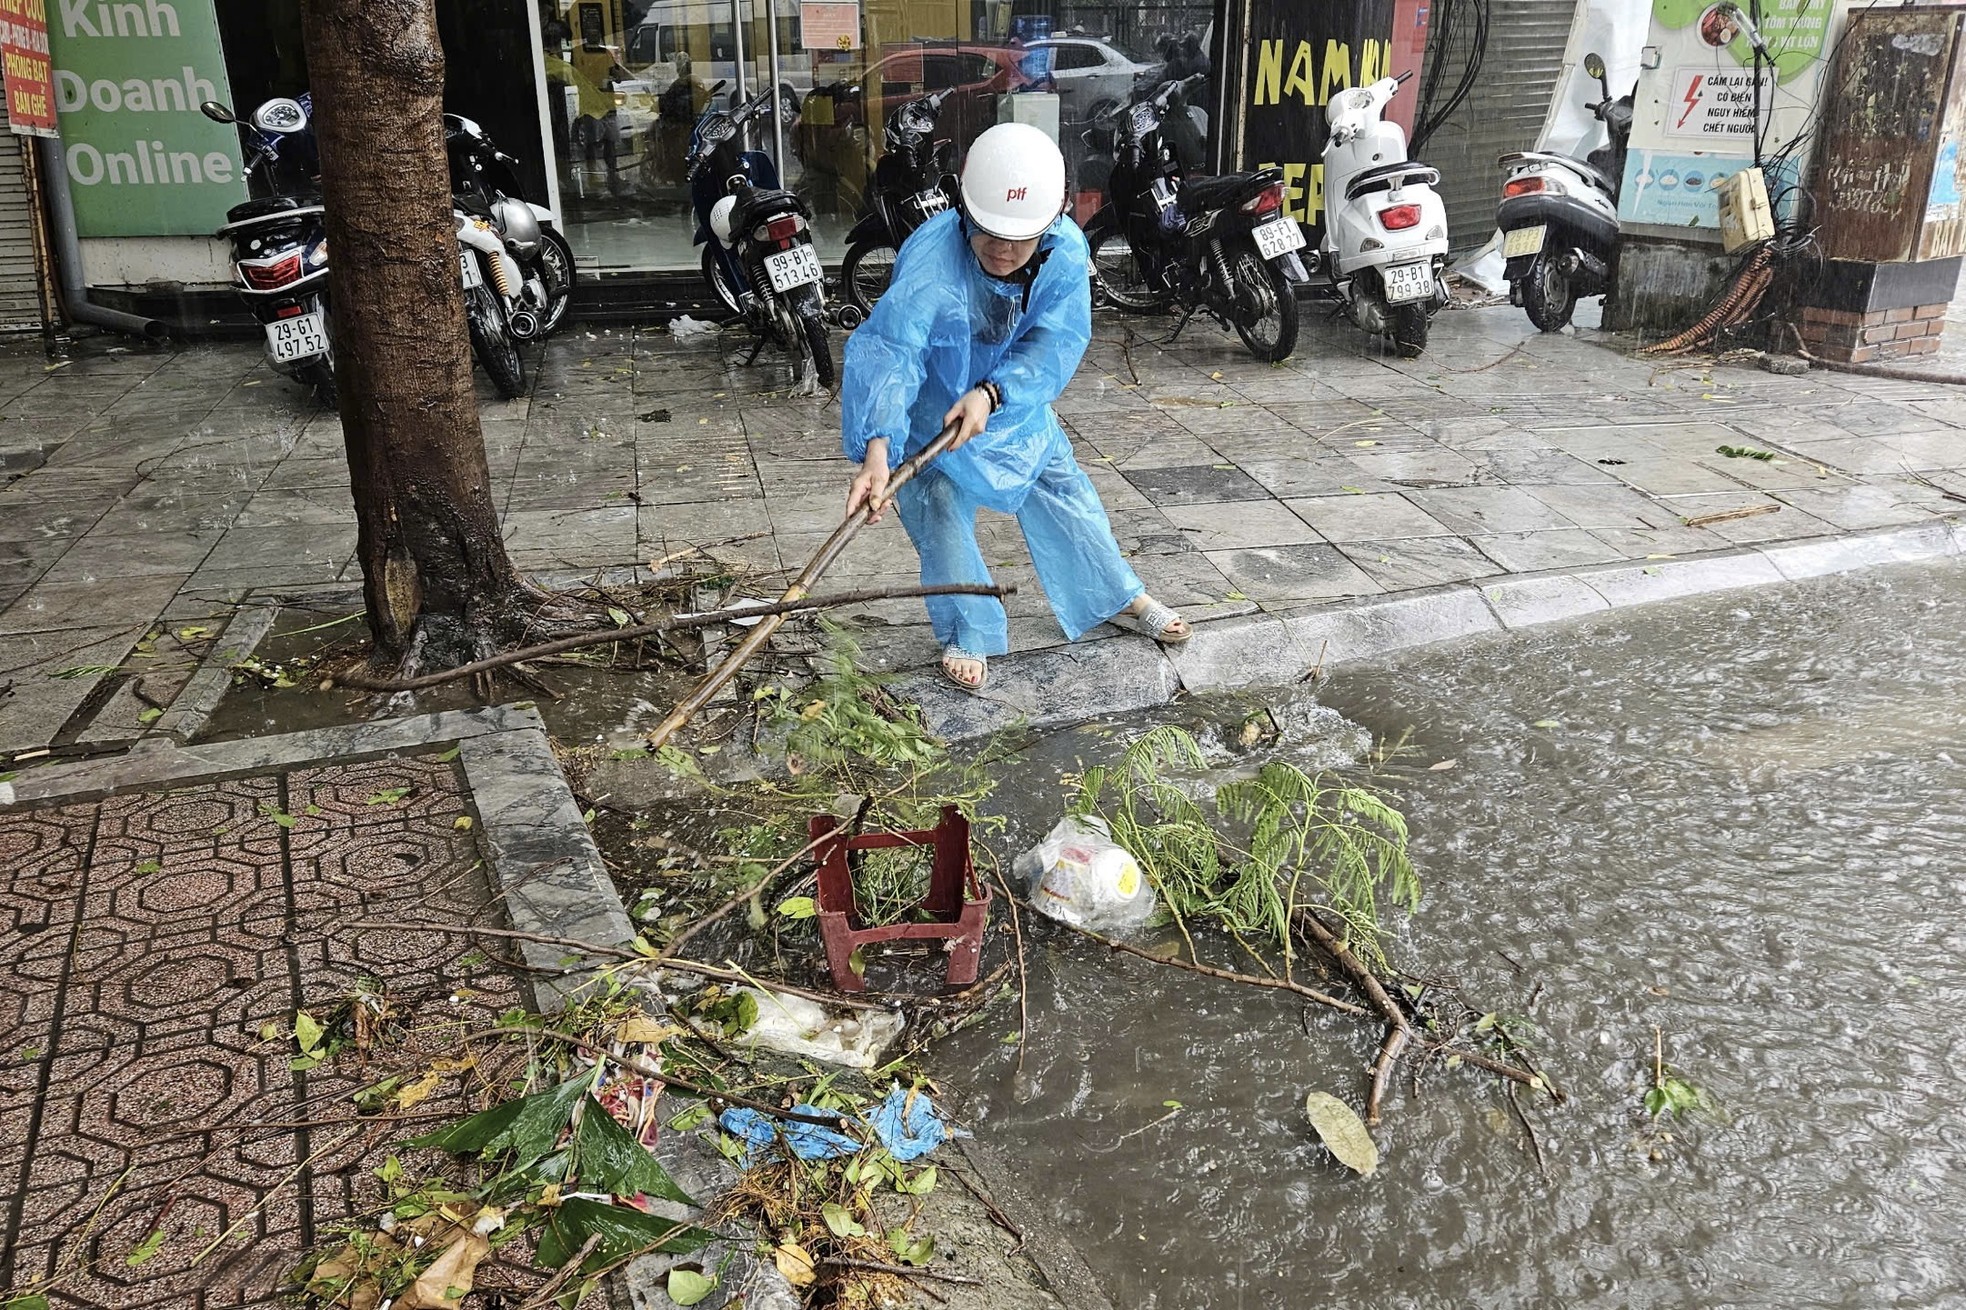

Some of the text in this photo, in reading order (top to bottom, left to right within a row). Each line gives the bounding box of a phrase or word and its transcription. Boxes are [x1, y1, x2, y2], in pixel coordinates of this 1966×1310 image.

[60, 0, 181, 38] Kinh
[1253, 39, 1352, 106] NAM
[52, 66, 217, 112] Doanh
[1707, 107, 1730, 118] NGUY
[1703, 120, 1725, 133] CHẾT
[65, 140, 235, 186] Online
[1260, 220, 1292, 241] 89-F1
[772, 249, 808, 272] 99-B1
[774, 262, 819, 289] 513.46
[1391, 266, 1424, 284] 29-B1
[274, 317, 314, 341] 29-G1
[276, 334, 325, 359] 497.52
